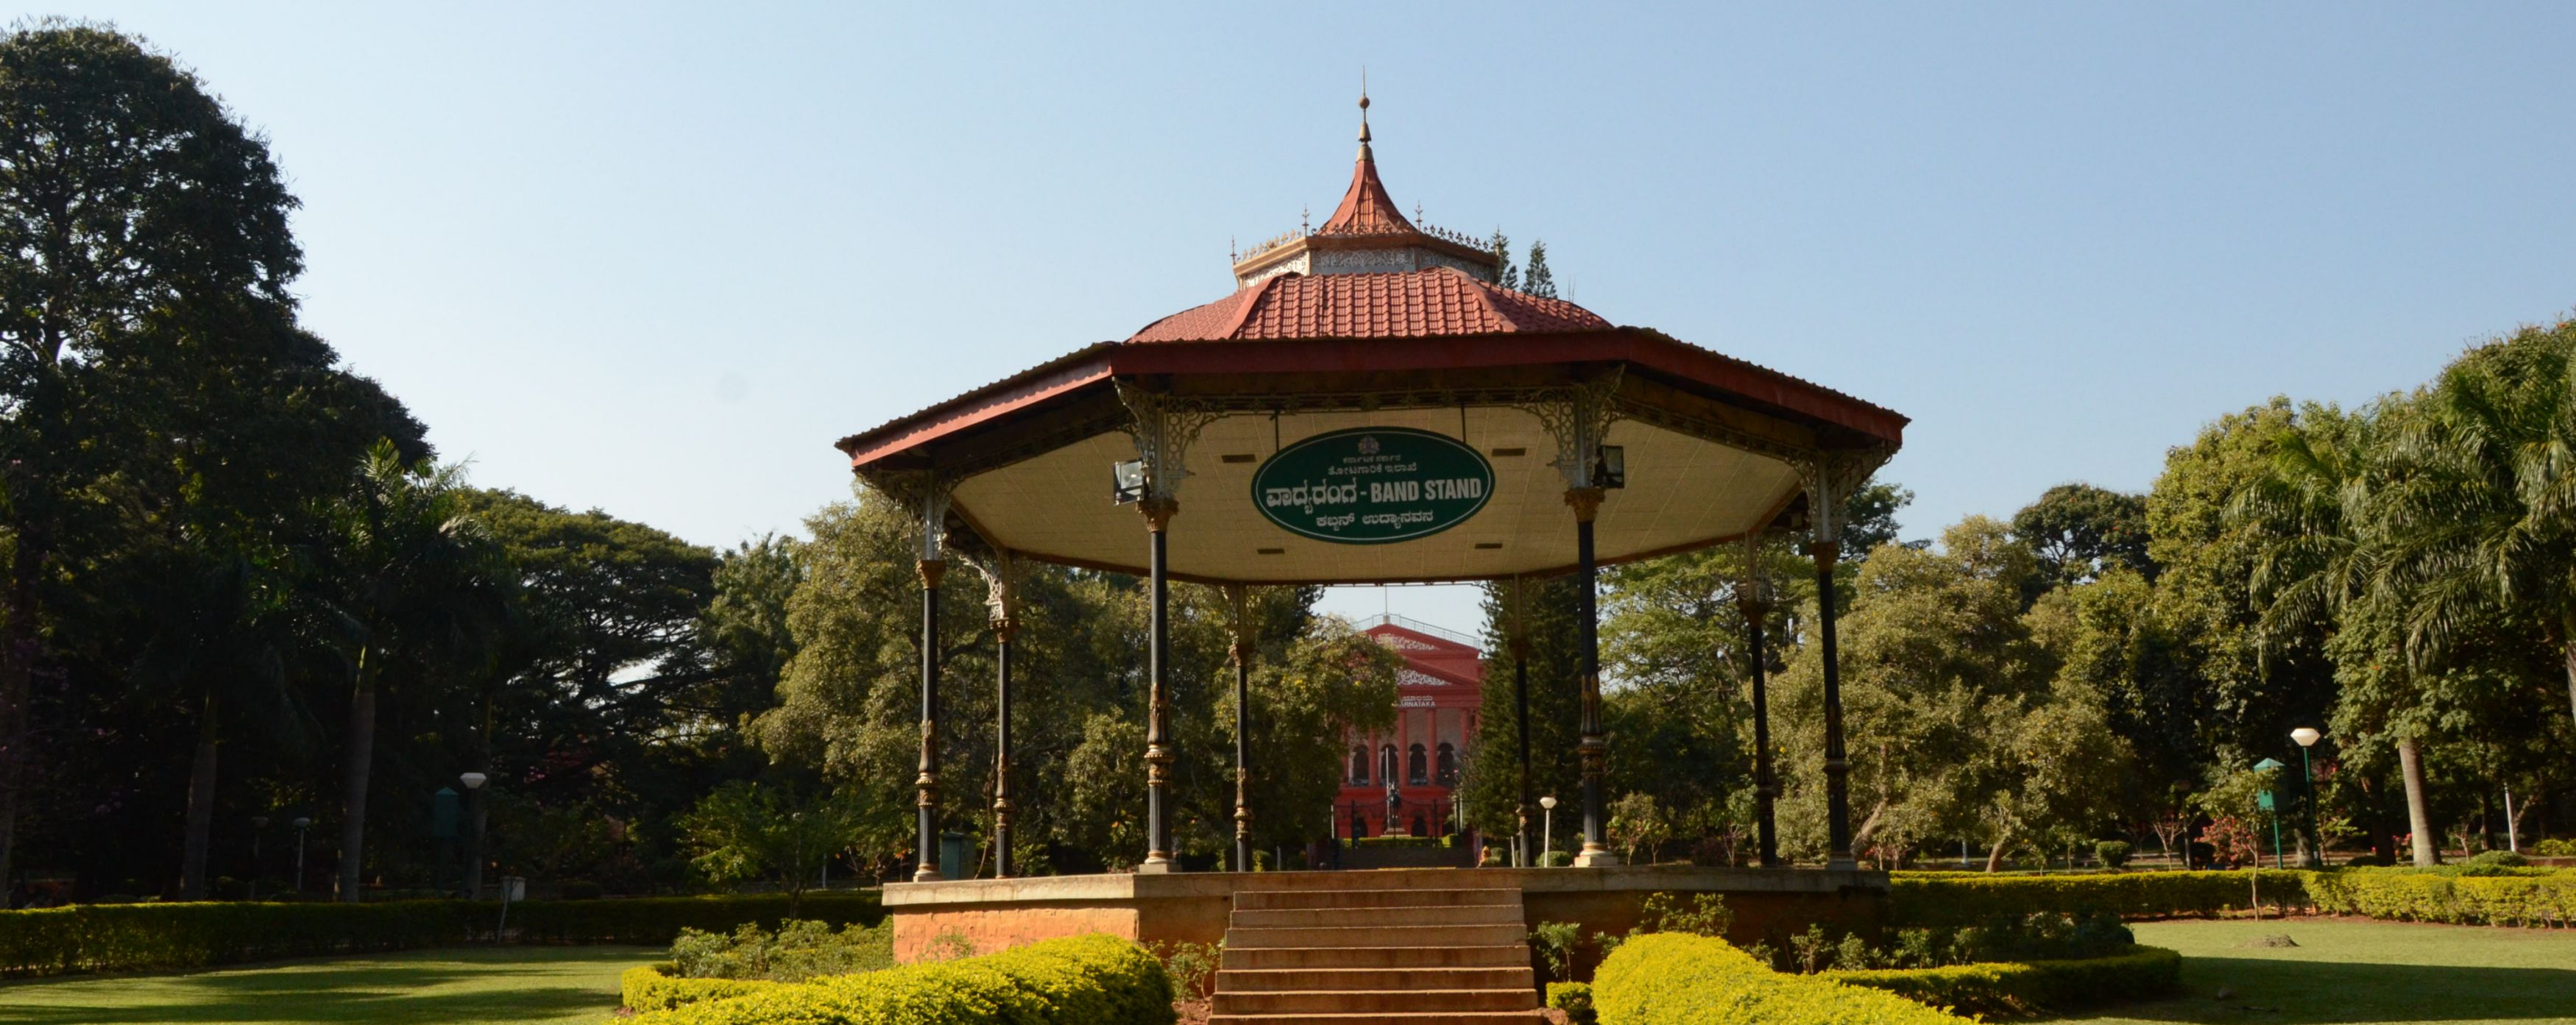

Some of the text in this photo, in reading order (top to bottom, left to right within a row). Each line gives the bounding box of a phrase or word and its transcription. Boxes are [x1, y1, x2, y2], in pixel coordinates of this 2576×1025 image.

[1327, 462, 1417, 475] ತೋಟಗಾರಿಕೆ ಇಲಾಖೆ
[1266, 478, 1356, 514] ವಾದ್ಯರಂಗ
[1370, 480, 1419, 503] BAND
[1425, 478, 1482, 500] STAND
[1316, 510, 1434, 531] ಕಬ್ಬನ್ ಉದ್ಯಾನವನ
